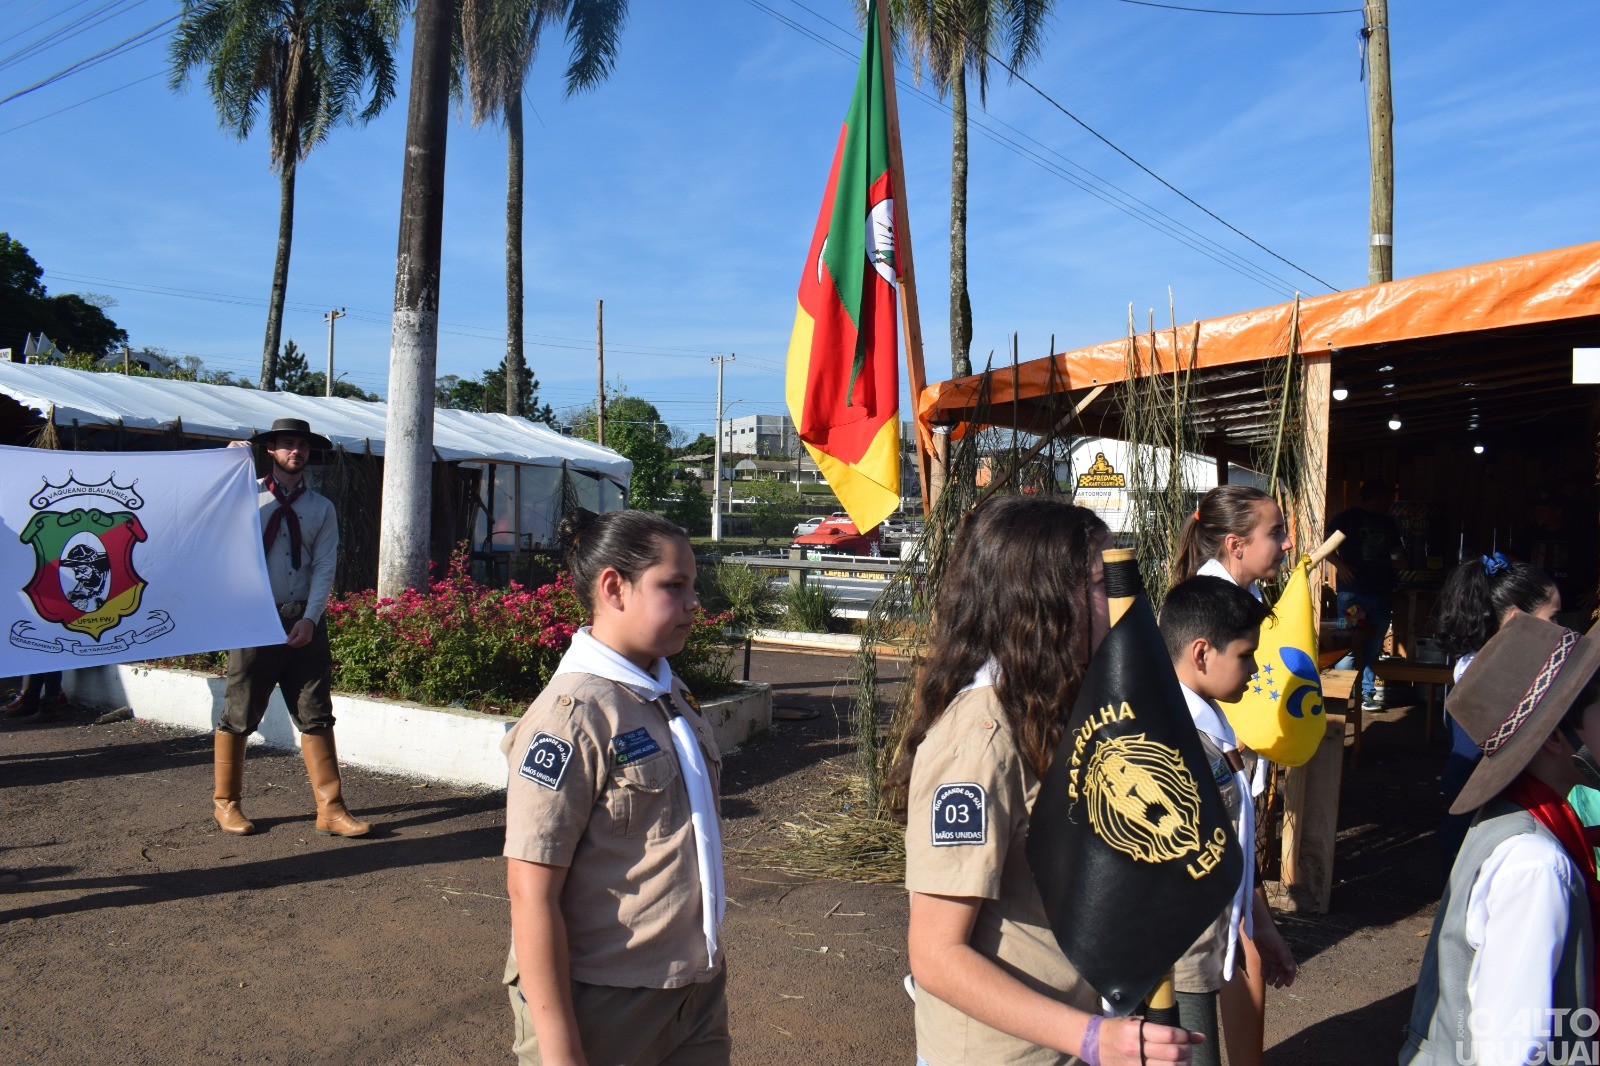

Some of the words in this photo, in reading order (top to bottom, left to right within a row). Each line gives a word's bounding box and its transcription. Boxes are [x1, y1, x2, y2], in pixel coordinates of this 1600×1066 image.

[47, 487, 86, 499] VAQUEANO
[106, 489, 128, 500] NUNES
[11, 636, 60, 651] DEPARTAMENTO
[539, 738, 559, 746] GRANDE
[557, 743, 565, 752] DO
[1068, 701, 1136, 798] PATRULHA
[534, 749, 555, 768] 03
[536, 771, 557, 785] UNIDAS
[941, 787, 965, 800] GRANDE
[964, 789, 975, 799] DO
[972, 797, 983, 810] SUL
[945, 803, 970, 824] 03
[935, 830, 954, 839] MÃOS
[954, 831, 982, 839] UNIDAS
[1186, 827, 1227, 880] LEÃO
